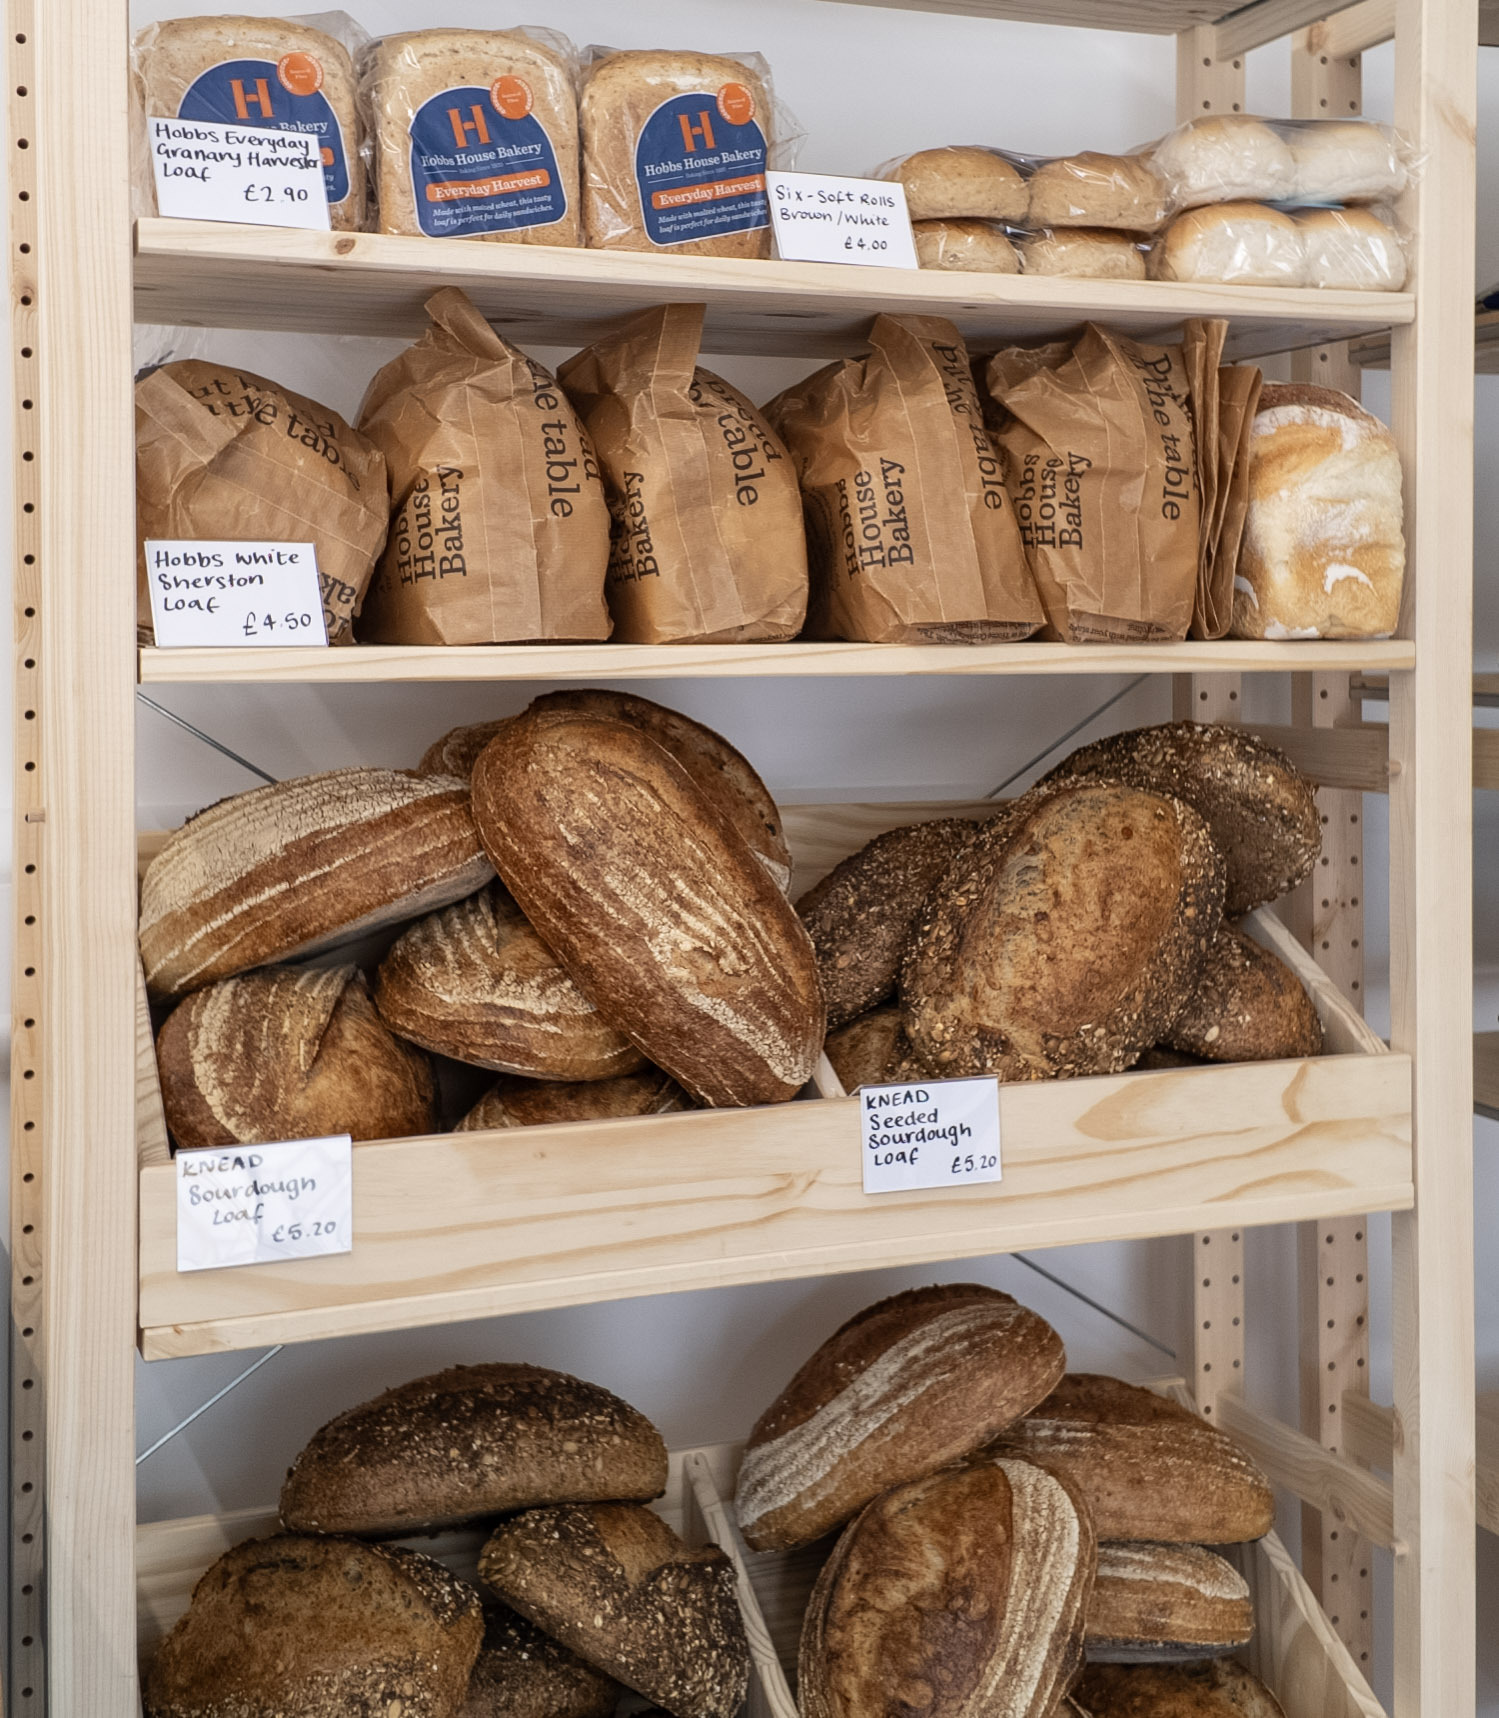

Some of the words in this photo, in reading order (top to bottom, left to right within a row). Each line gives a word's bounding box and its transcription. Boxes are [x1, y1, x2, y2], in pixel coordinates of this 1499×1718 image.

[229, 78, 275, 120] H
[155, 123, 220, 143] Hobbs
[225, 131, 310, 157] Everyday
[446, 104, 493, 149] H
[676, 111, 716, 153] H
[156, 143, 242, 168] Granary
[421, 155, 456, 167] Hobbs
[455, 152, 496, 165] House
[496, 143, 542, 159] Bakery
[644, 161, 683, 177] Hobbs
[683, 157, 720, 170] House
[720, 148, 763, 164] Bakery
[163, 163, 212, 182] Loaf
[243, 184, 309, 203] £2.90
[435, 183, 491, 199] Everyday
[492, 175, 542, 192] Harvest
[659, 188, 714, 205] Everyday
[714, 180, 762, 196] Harvest
[860, 193, 895, 208] Rolls
[844, 236, 888, 250] £4.00
[717, 413, 766, 507] table
[1143, 376, 1171, 428] the
[1161, 433, 1190, 521] table
[541, 419, 581, 518] table
[969, 423, 1007, 510] table
[879, 456, 915, 568] Bakery
[1013, 453, 1040, 550] Hobbs
[1032, 458, 1064, 550] House
[1058, 450, 1092, 551] Bakery
[413, 477, 438, 584] House
[435, 463, 467, 580] Bakery
[623, 471, 660, 581] Bakery
[853, 470, 886, 569] House
[154, 550, 225, 568] Hobbs
[158, 572, 265, 592] Sherston
[163, 596, 221, 614] Loaf
[242, 611, 312, 637] £4.50
[866, 1089, 930, 1111] KNEAD
[869, 1108, 939, 1131] Seeded
[868, 1122, 972, 1150] Sourdough
[182, 1154, 263, 1177] KNEAD
[951, 1154, 997, 1174] £5.20
[188, 1176, 316, 1206] Sourdough
[212, 1203, 265, 1226] Loaf
[272, 1221, 337, 1243] £5.20
